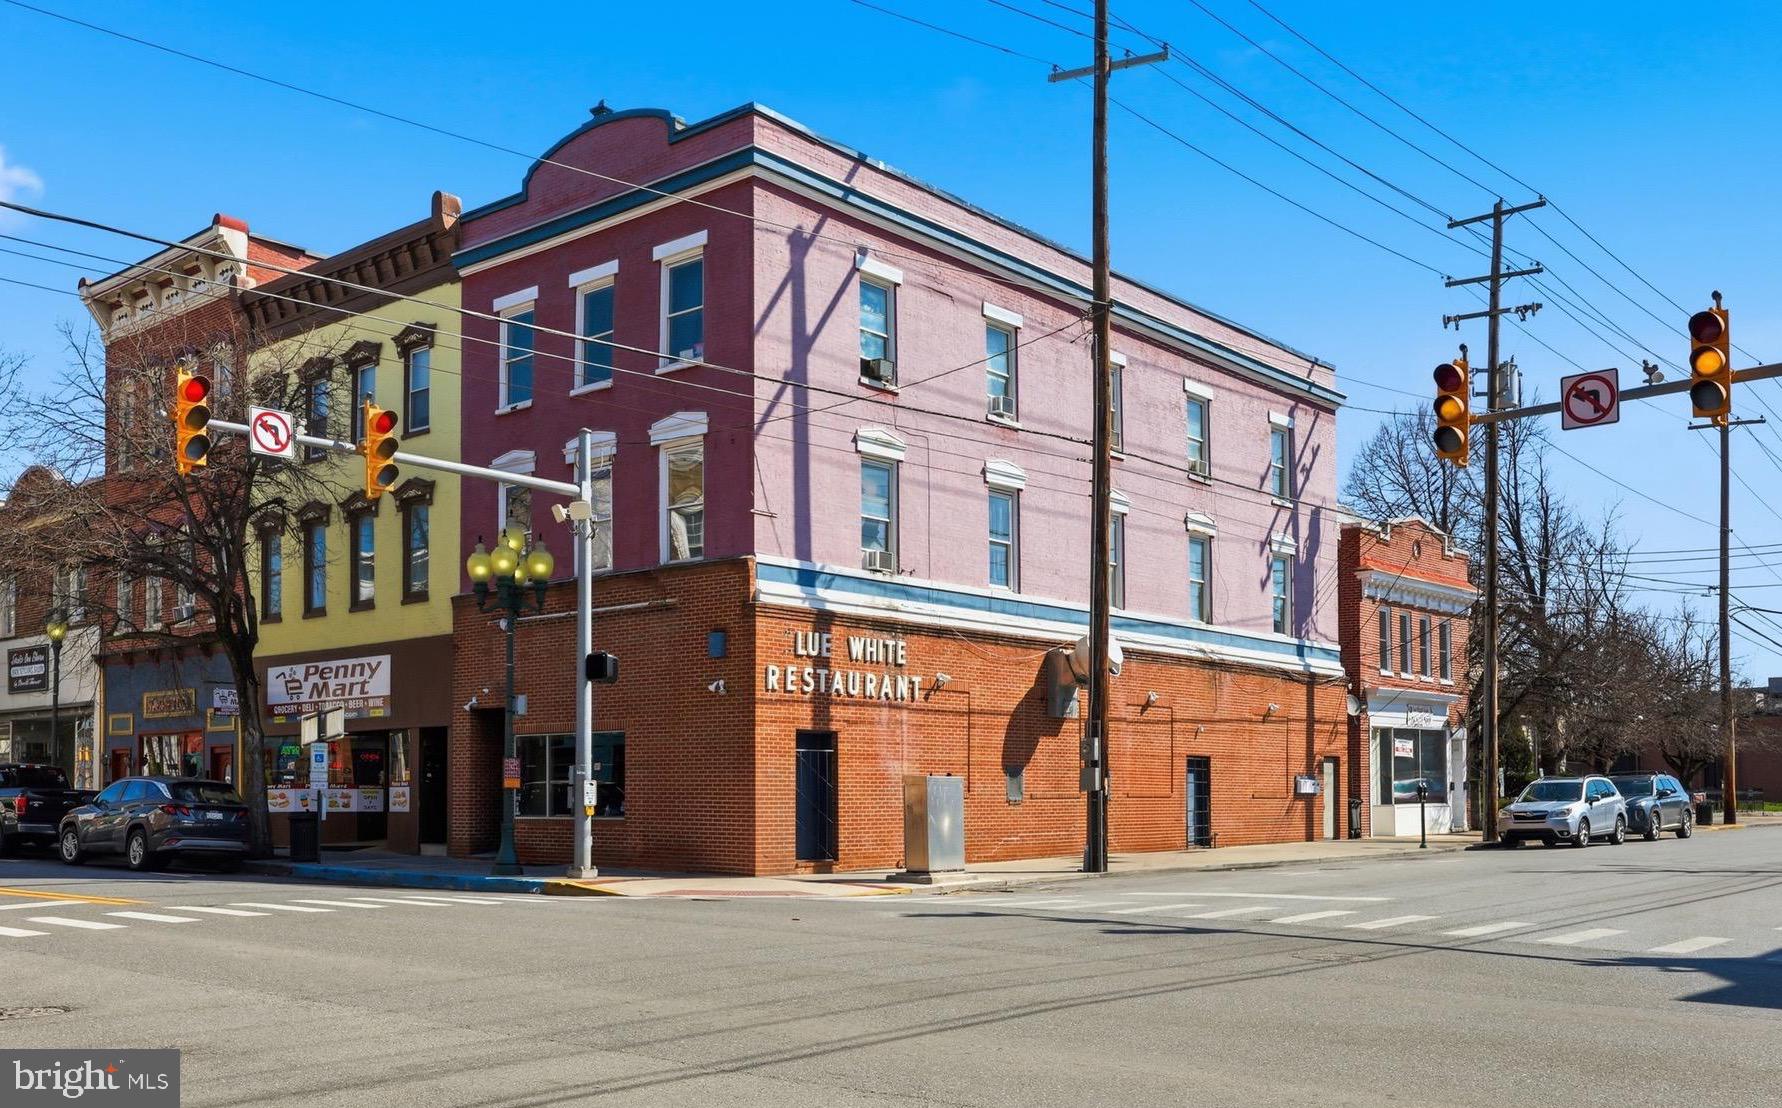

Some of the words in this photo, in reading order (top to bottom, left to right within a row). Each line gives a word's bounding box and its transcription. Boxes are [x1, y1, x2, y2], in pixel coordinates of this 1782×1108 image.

[795, 631, 832, 657] LUE
[848, 636, 907, 665] WHITE
[303, 661, 382, 682] Penny
[308, 679, 371, 700] Mart
[766, 665, 922, 701] RESTAURANT
[273, 704, 298, 714] GROCERY
[302, 703, 315, 712] DELI
[348, 699, 364, 709] BEER
[368, 698, 384, 707] WINE
